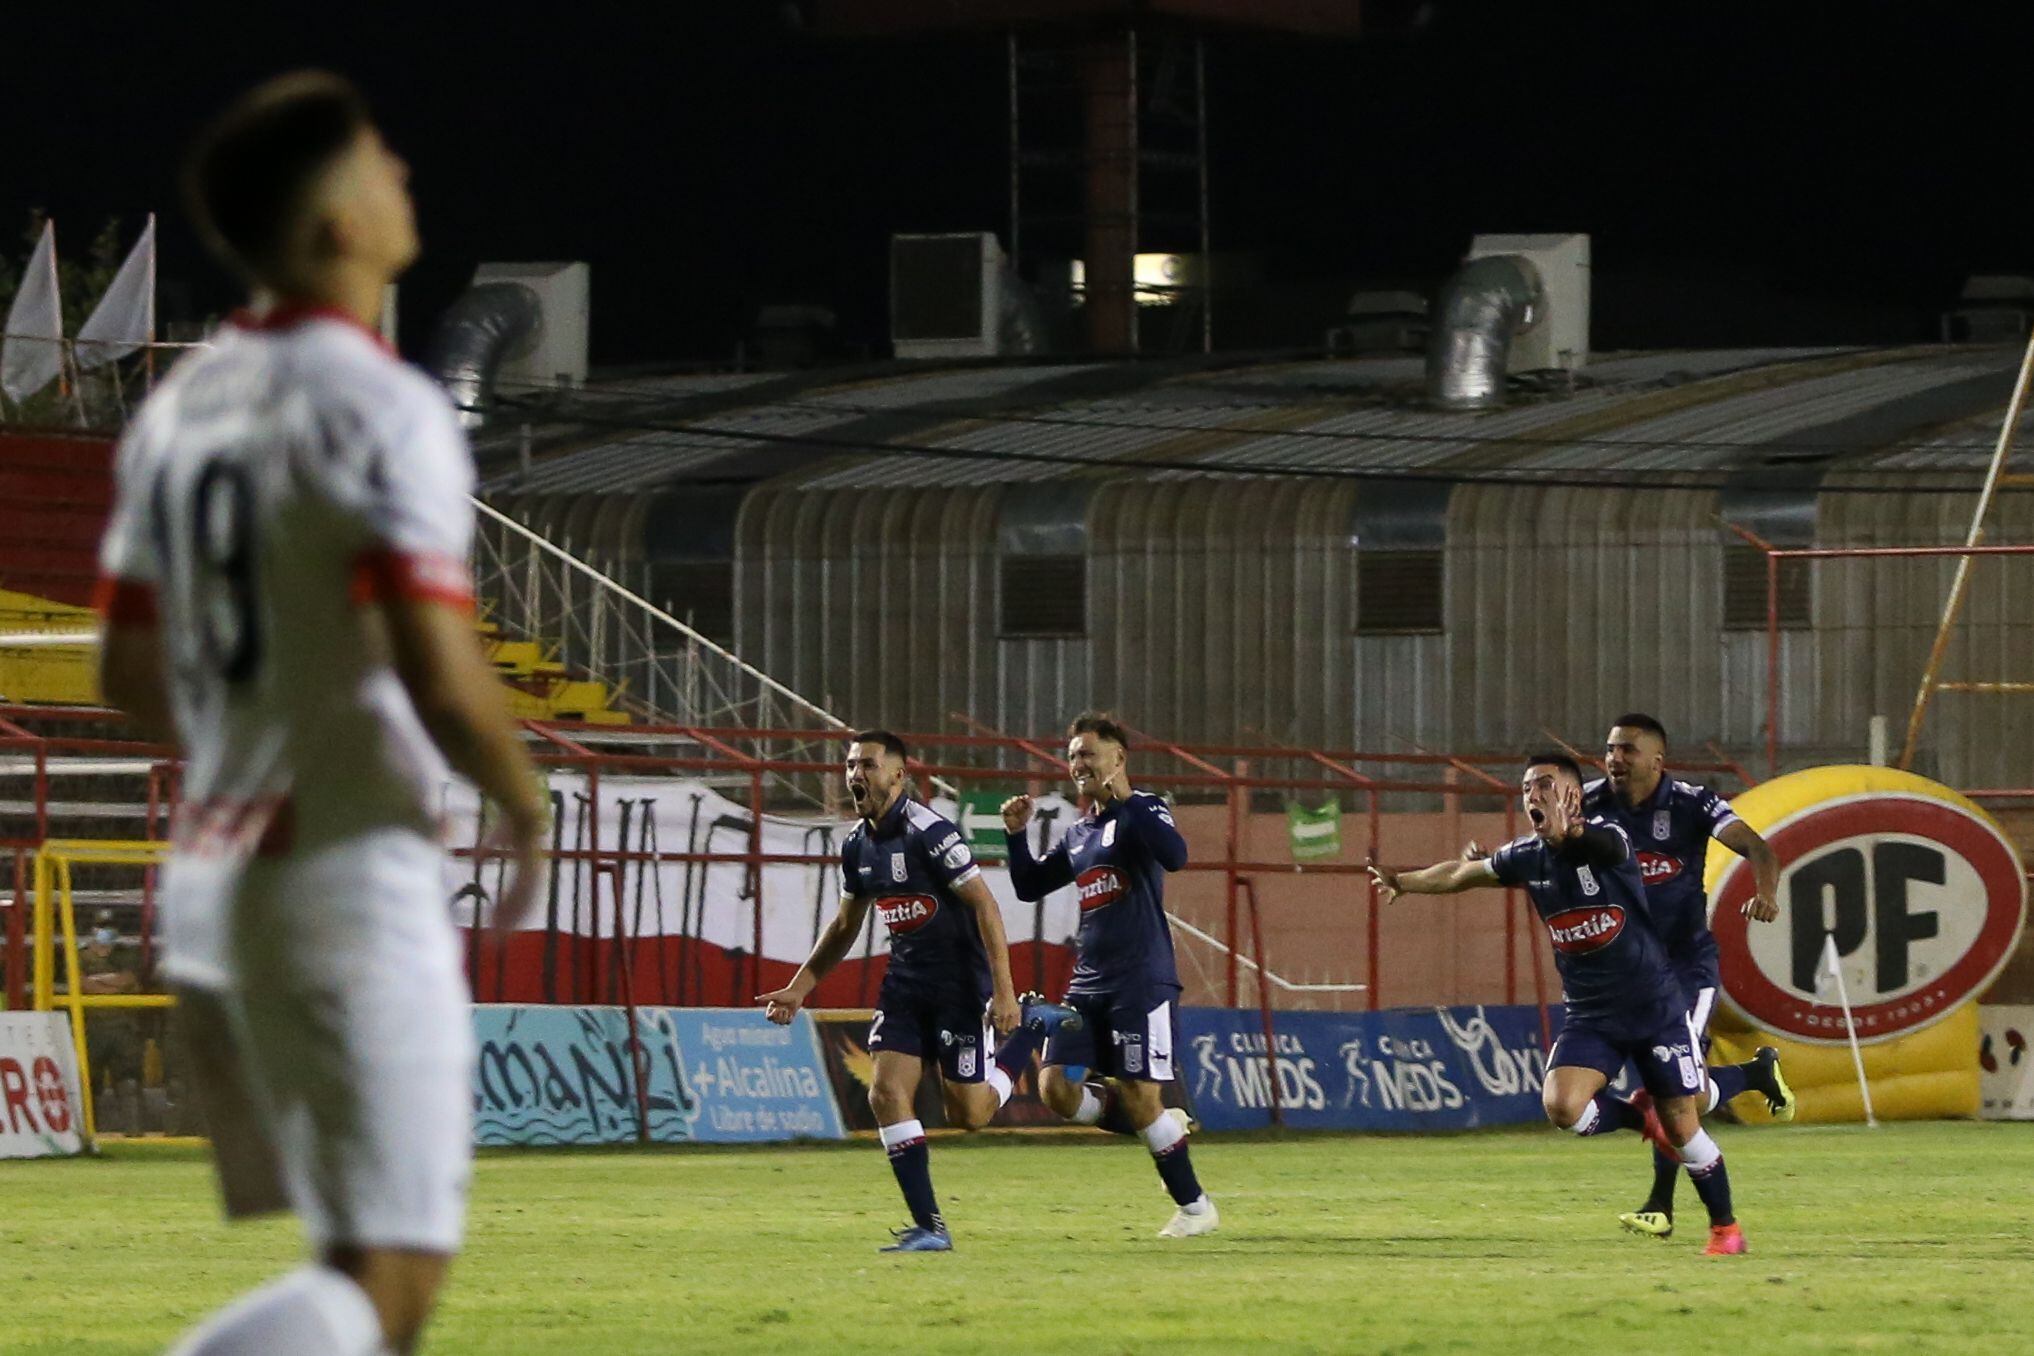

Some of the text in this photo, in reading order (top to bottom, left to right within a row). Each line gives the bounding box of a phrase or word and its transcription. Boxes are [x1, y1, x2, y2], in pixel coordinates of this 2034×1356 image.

[1789, 841, 1946, 996] PF
[0, 1056, 70, 1134] RO
[716, 1055, 821, 1098] Alcalina
